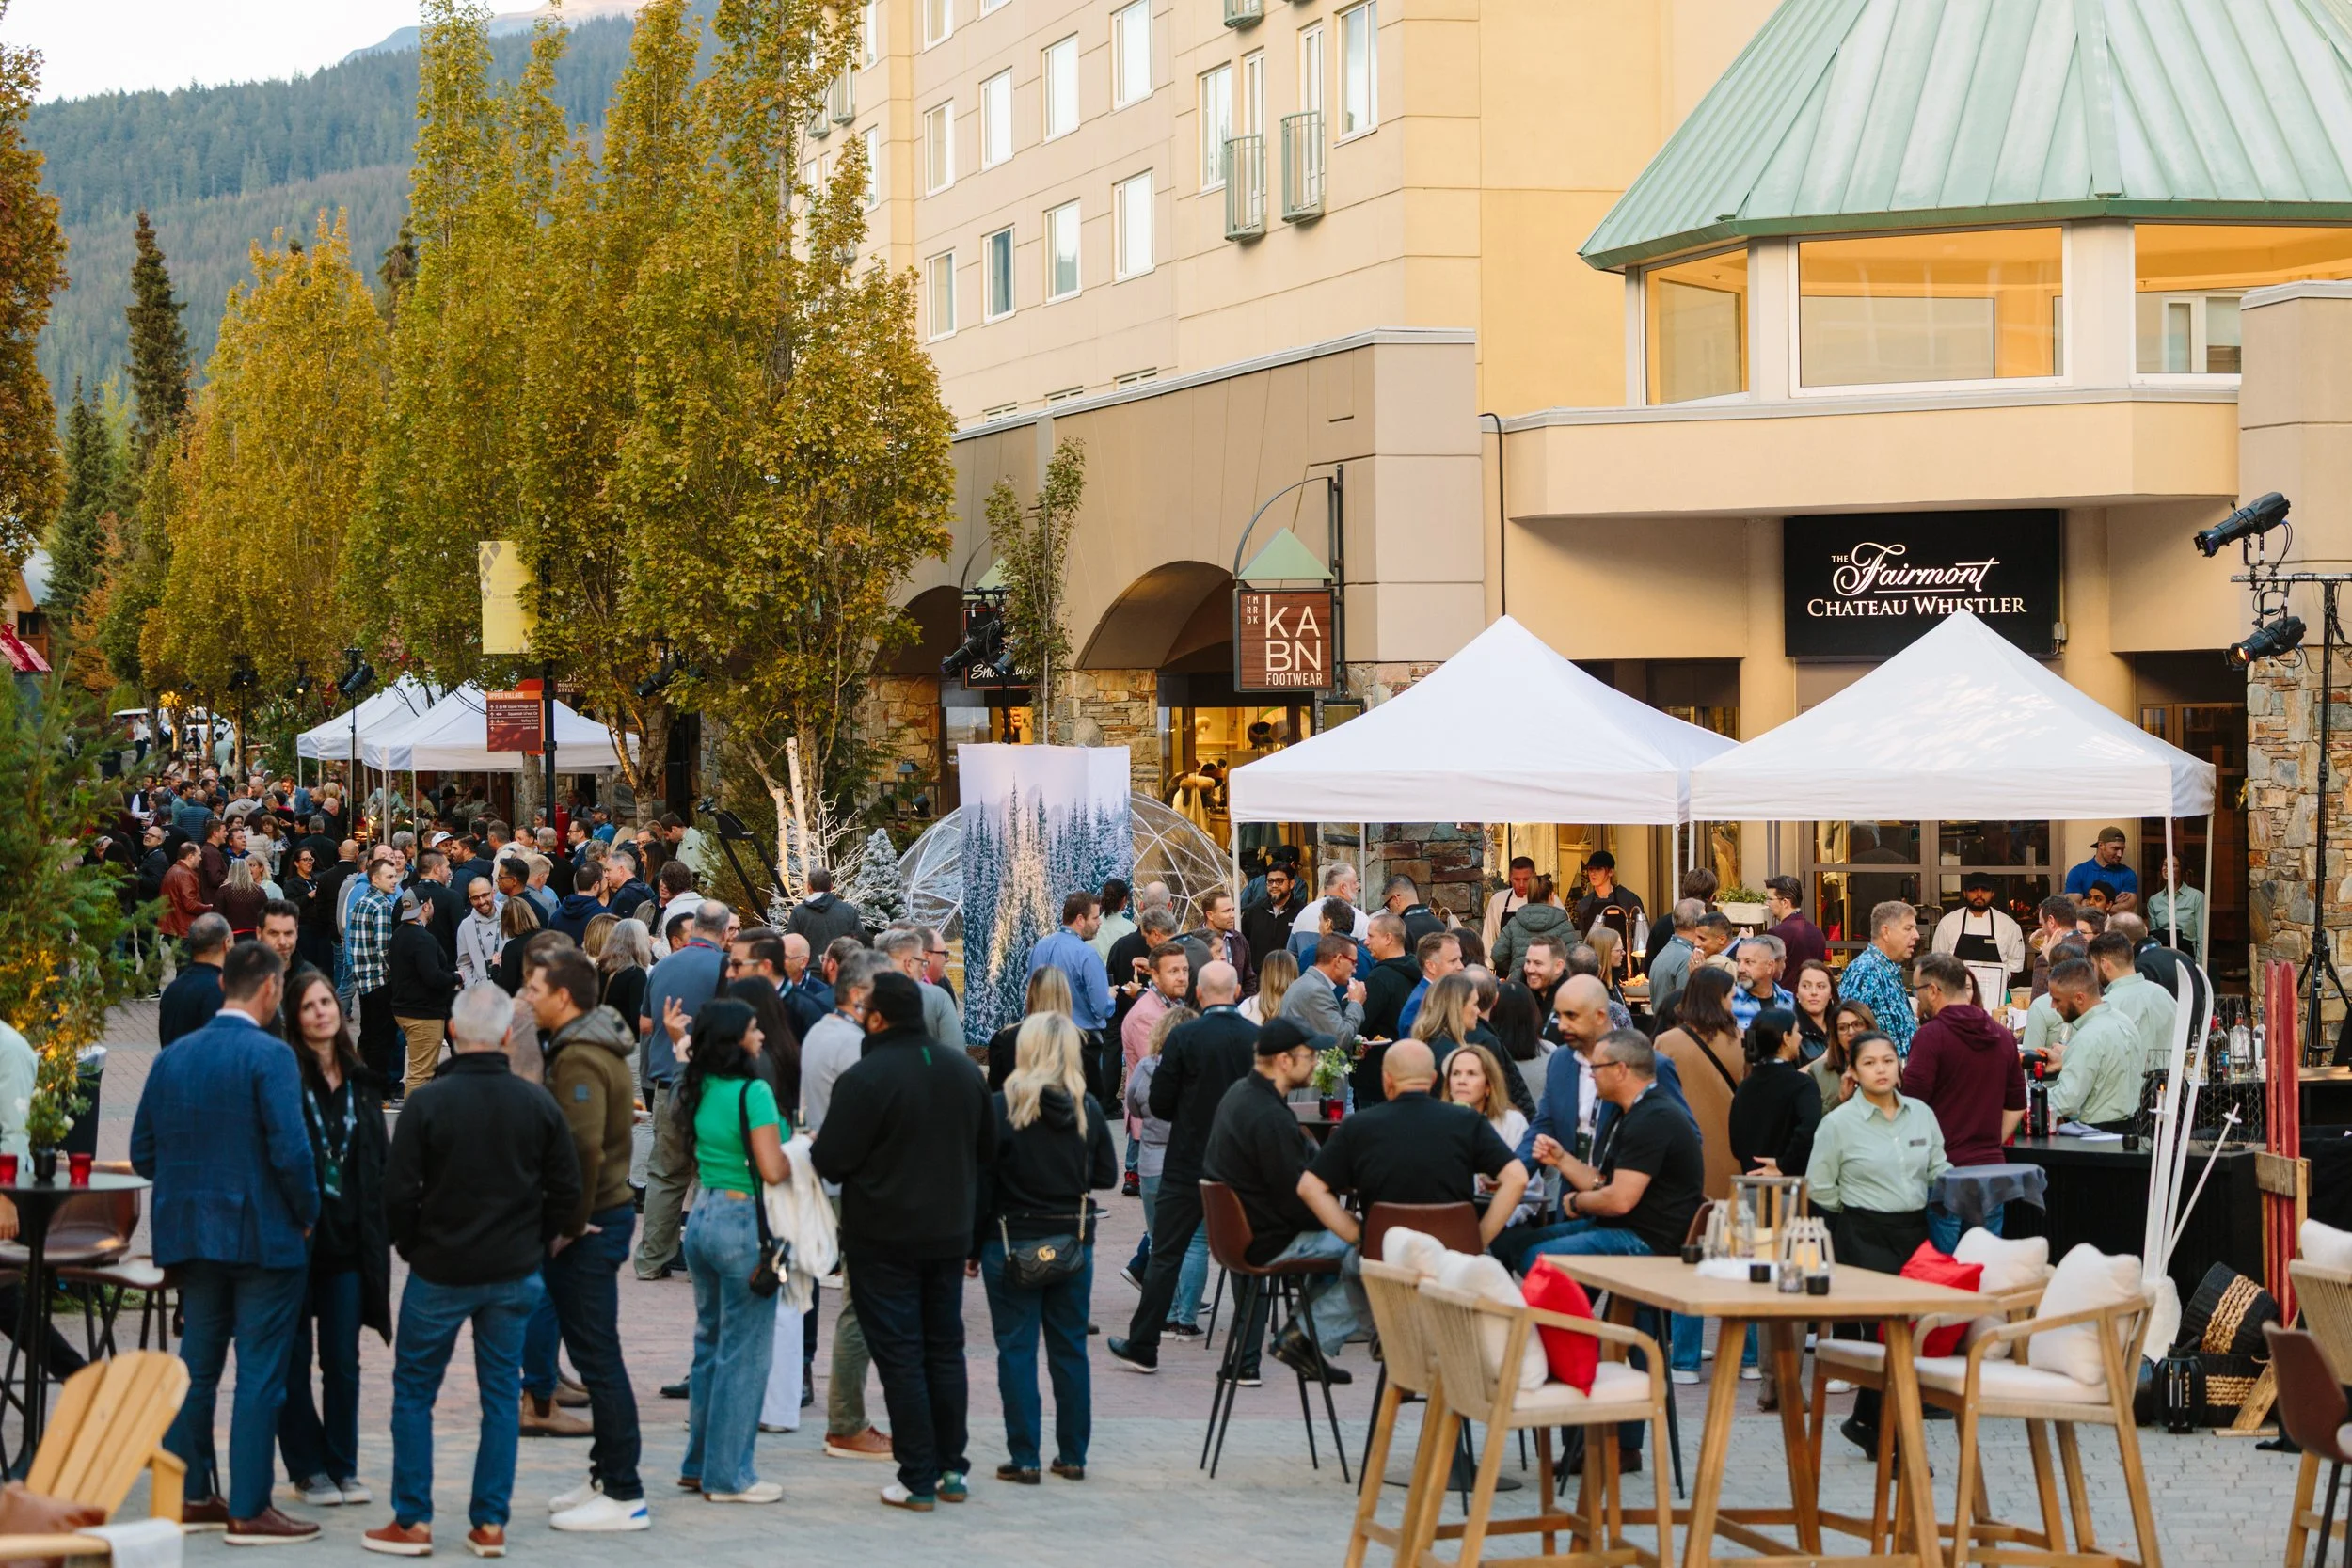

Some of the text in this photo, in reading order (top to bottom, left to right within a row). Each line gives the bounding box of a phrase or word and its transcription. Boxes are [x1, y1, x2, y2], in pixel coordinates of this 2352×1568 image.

[1831, 542, 2000, 596] THE Fairmont
[1806, 595, 2027, 617] CHATEAU WHISTLER
[1265, 673, 1323, 686] FOOTWEAR
